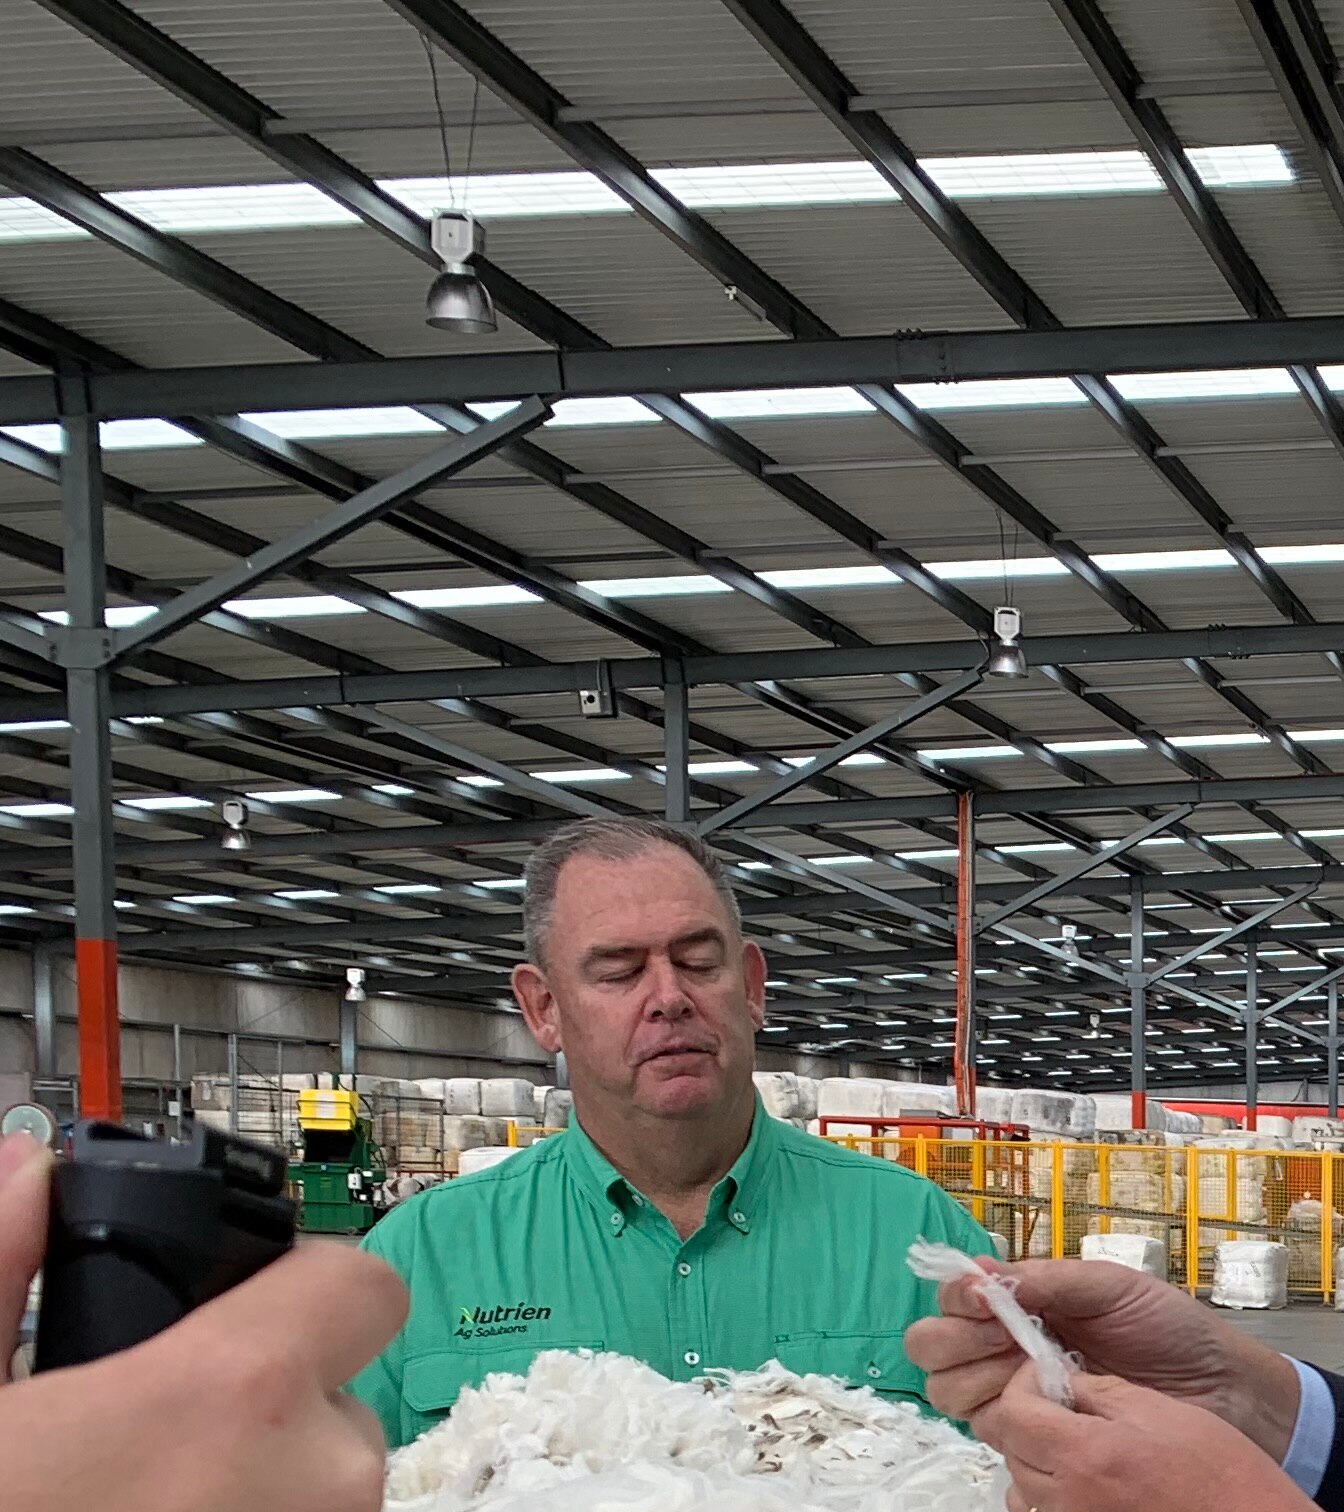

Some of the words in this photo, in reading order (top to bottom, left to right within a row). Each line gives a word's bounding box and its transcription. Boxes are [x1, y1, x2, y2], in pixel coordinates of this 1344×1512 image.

[457, 1302, 552, 1325] Nutrien
[454, 1326, 473, 1340] Ag
[474, 1324, 528, 1338] Solutions
